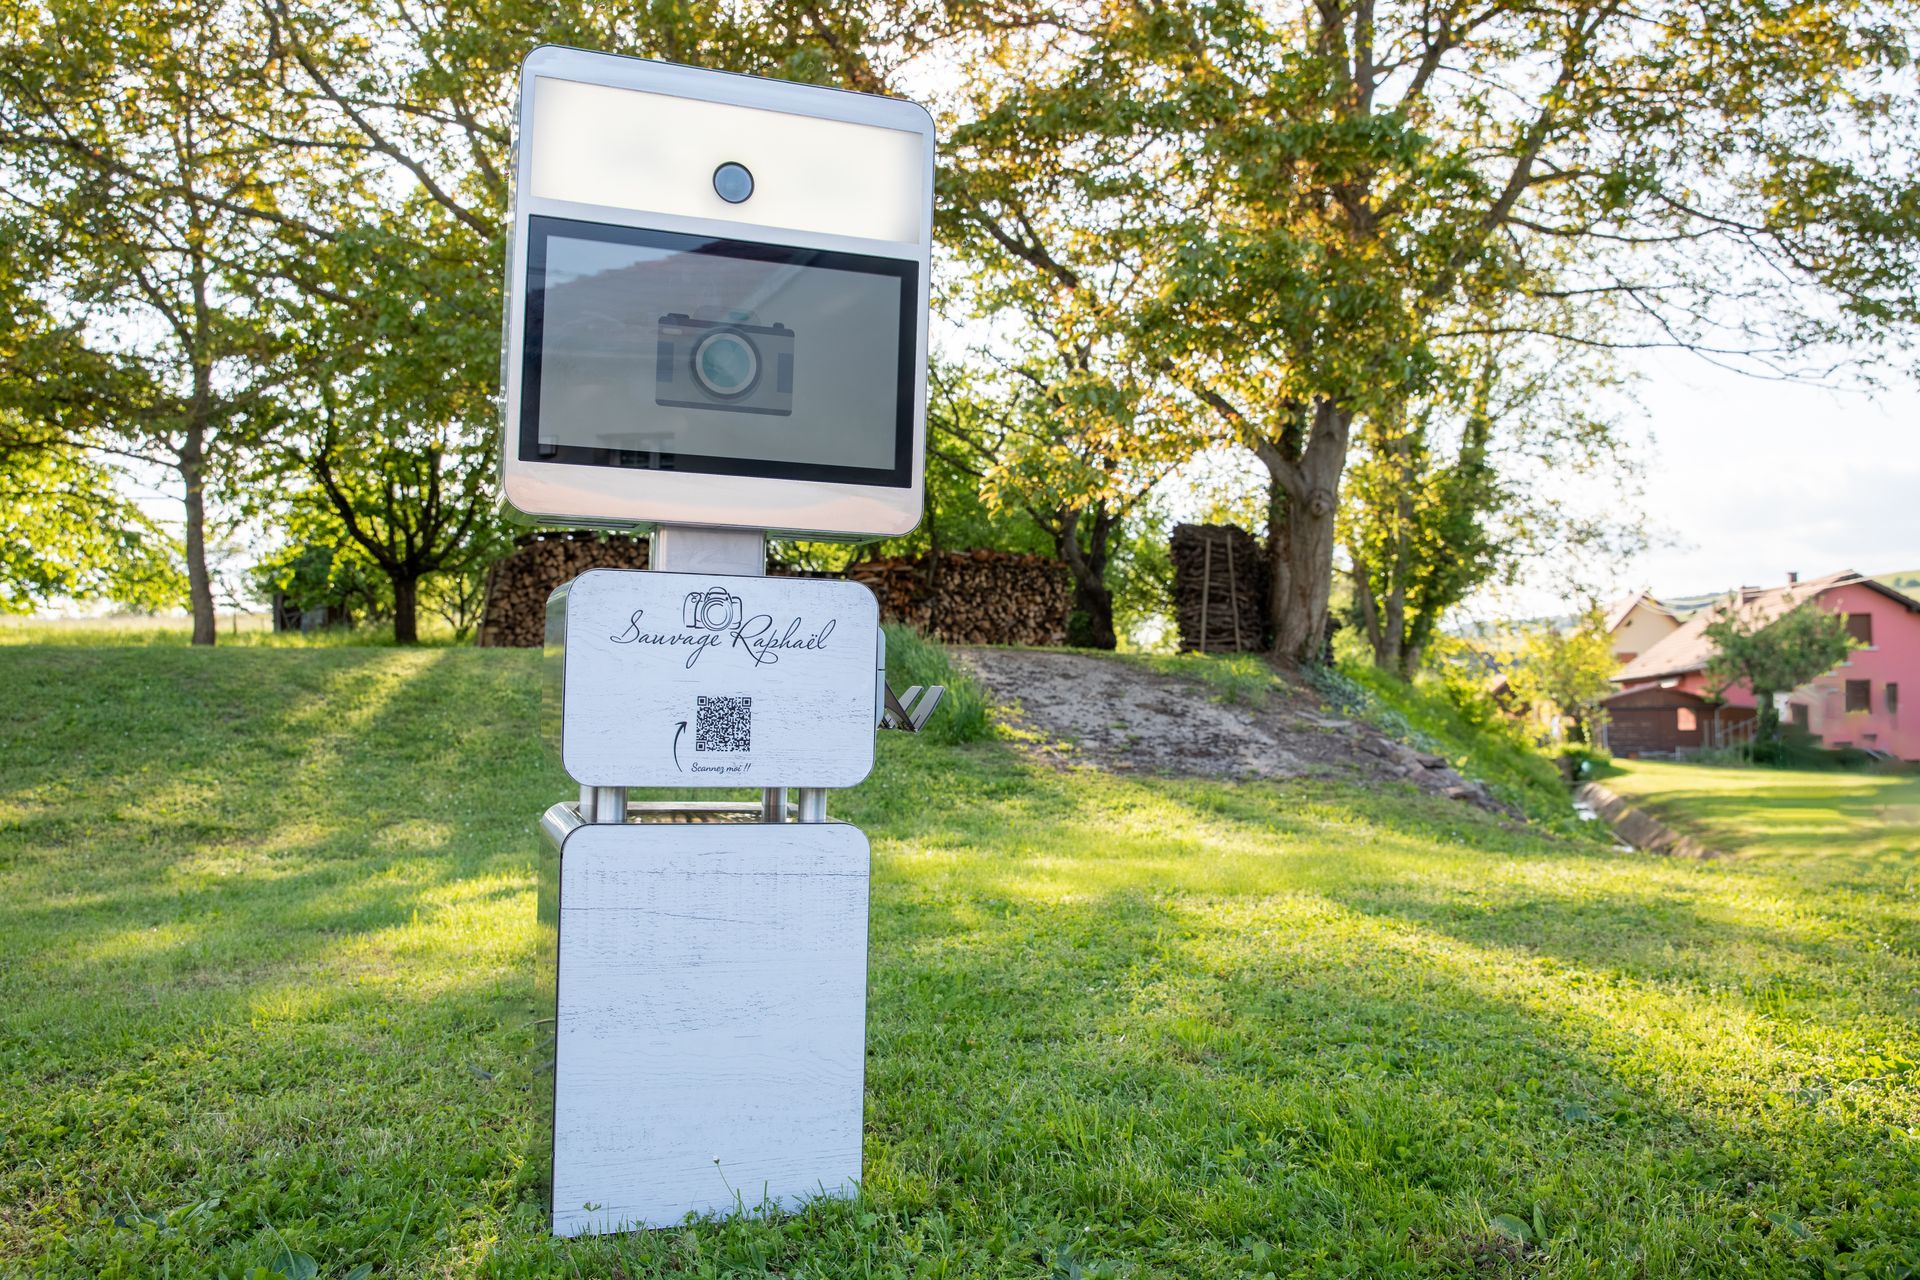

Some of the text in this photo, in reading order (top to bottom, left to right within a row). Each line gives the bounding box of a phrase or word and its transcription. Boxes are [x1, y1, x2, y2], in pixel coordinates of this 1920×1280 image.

[610, 609, 837, 669] Sauvage Raphaël
[691, 762, 725, 774] Scannez
[726, 764, 742, 772] moi
